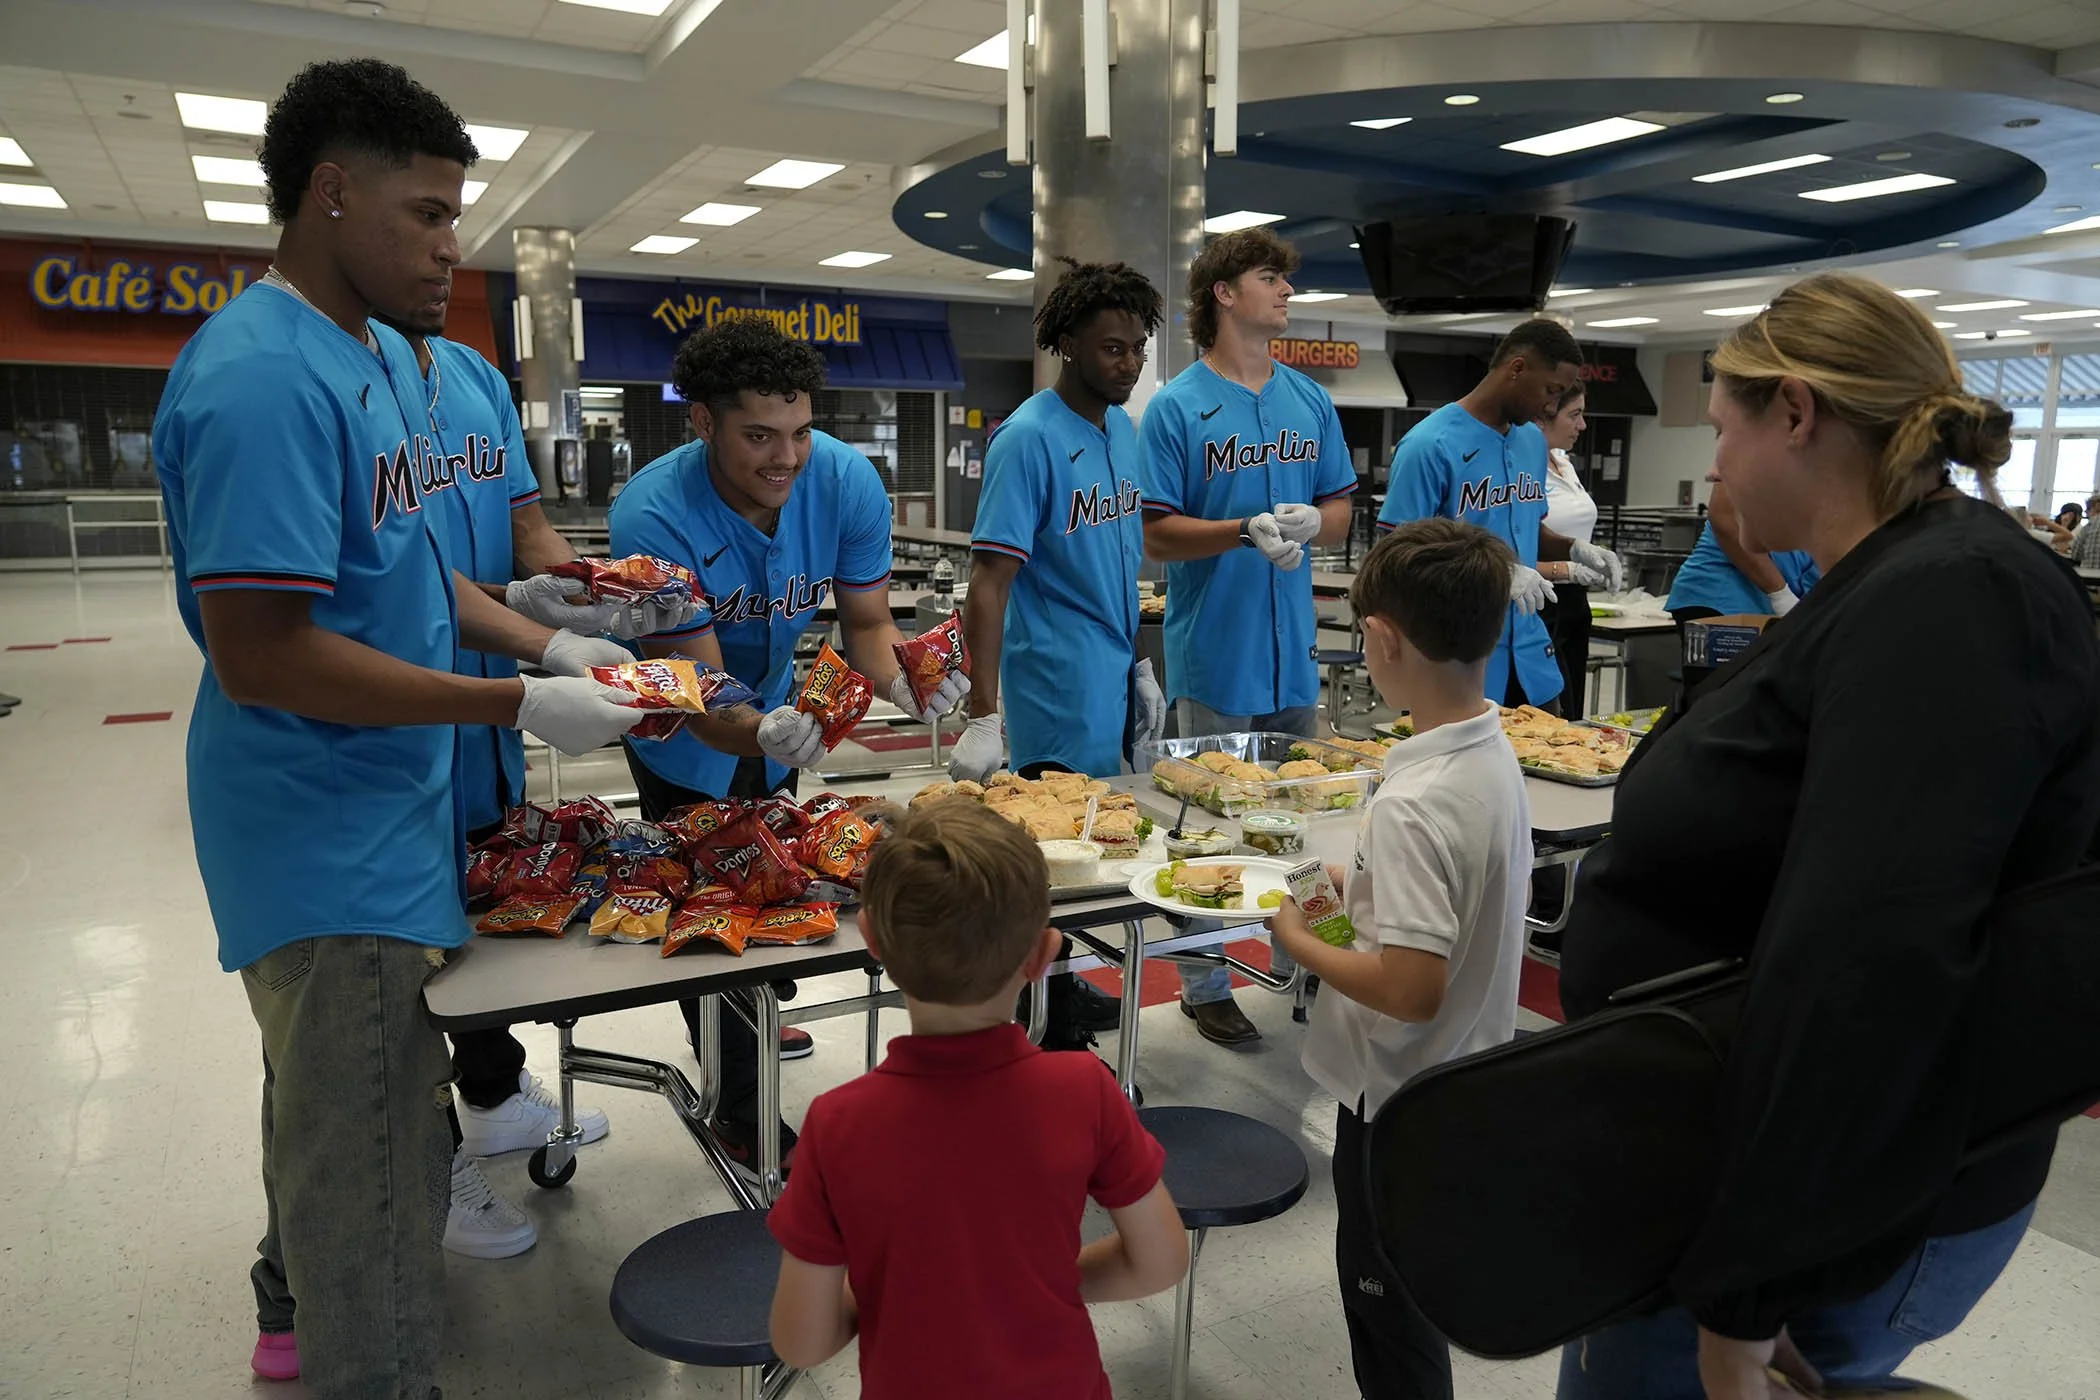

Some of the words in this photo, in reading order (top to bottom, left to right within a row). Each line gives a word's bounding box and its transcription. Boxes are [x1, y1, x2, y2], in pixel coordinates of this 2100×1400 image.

[32, 257, 151, 310] Café
[652, 294, 703, 333] The
[814, 303, 860, 342] Deli
[1269, 339, 1359, 368] BURGERS
[1204, 428, 1319, 481] Marlin
[1066, 478, 1141, 535] Marlin
[1456, 471, 1545, 518] Marlin
[702, 573, 833, 627] Marlin
[530, 841, 558, 877] Doritos
[714, 842, 761, 874] Doritos
[1287, 861, 1321, 884] Honest
